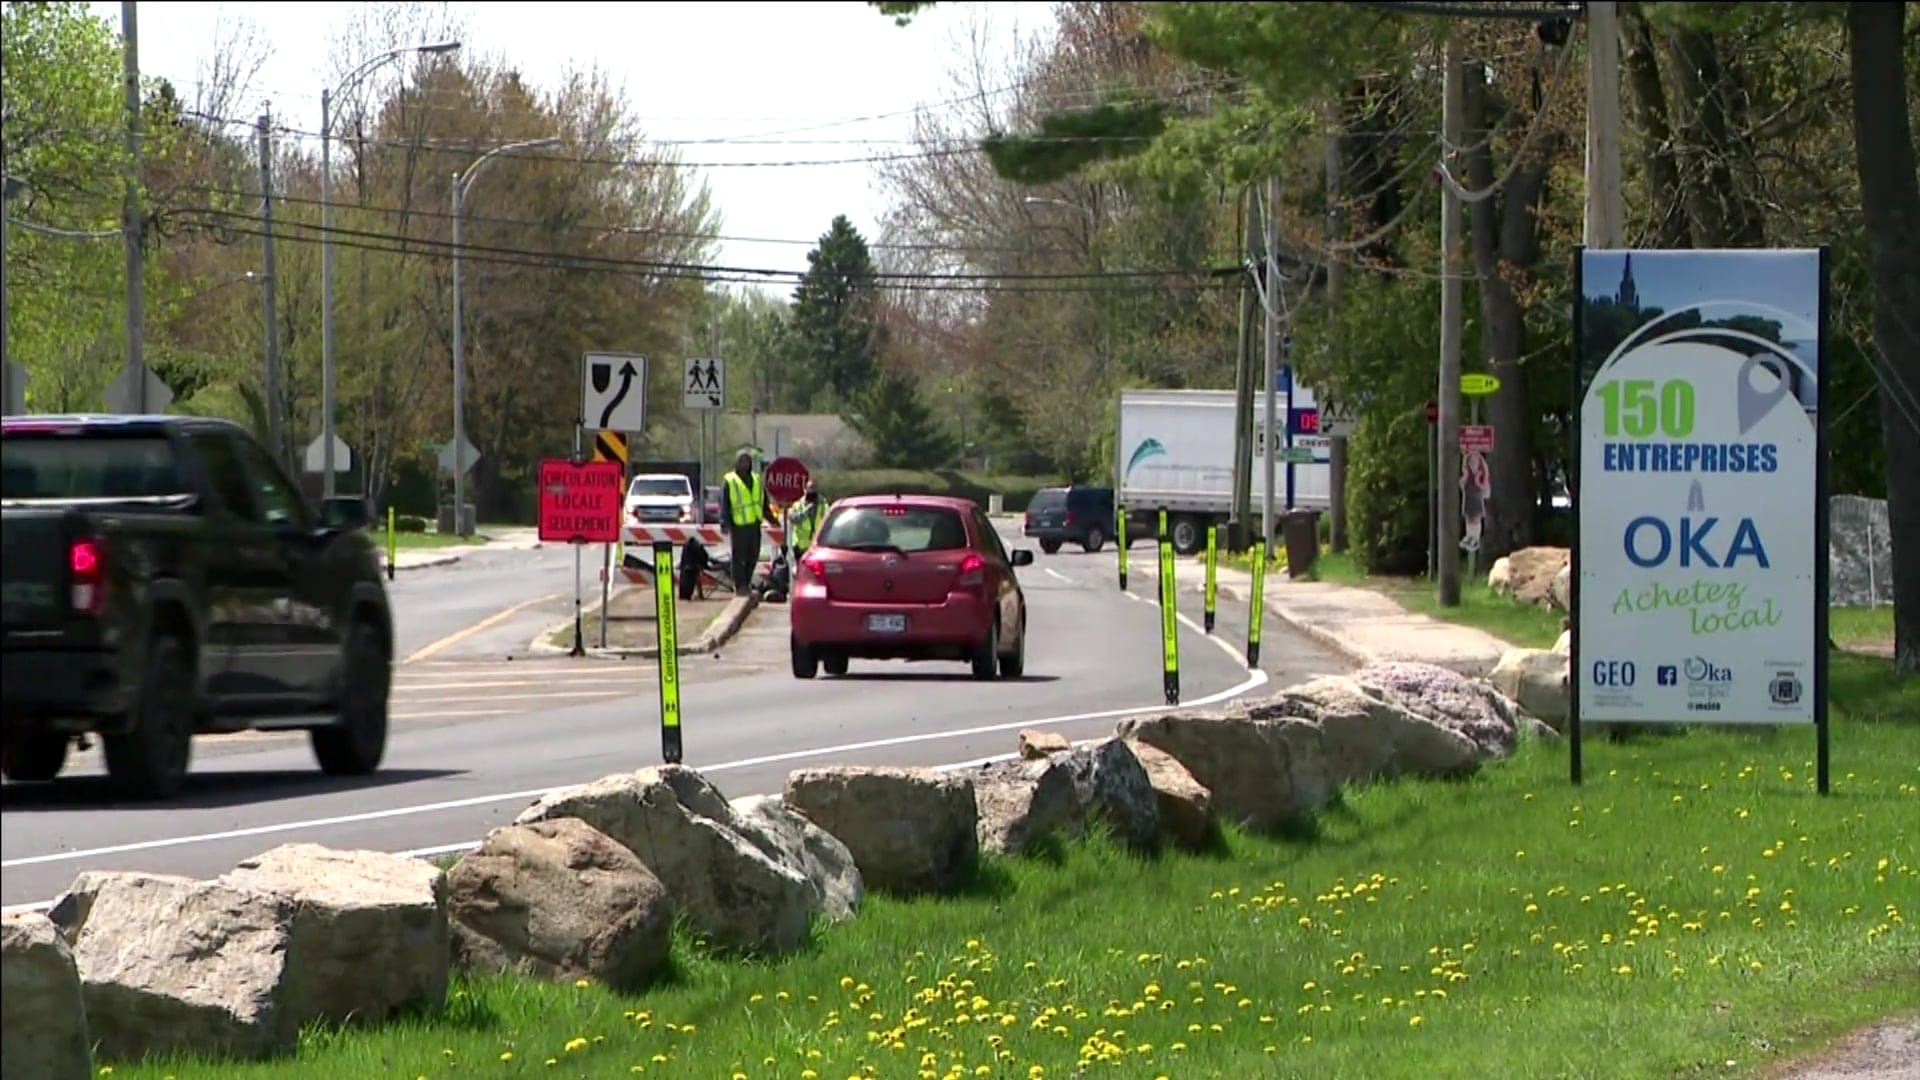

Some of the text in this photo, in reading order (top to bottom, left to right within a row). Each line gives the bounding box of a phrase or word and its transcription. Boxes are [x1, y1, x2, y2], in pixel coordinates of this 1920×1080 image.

[1596, 379, 1695, 438] 150
[1604, 443, 1777, 472] ENTREPRISES
[768, 471, 808, 489] ARRÊT
[555, 493, 603, 509] LOCALE
[549, 514, 611, 532] SEULEMENT
[1623, 516, 1770, 569] OKA
[1612, 578, 1748, 615] Achetez
[1688, 597, 1782, 635] local
[663, 639, 674, 684] Corridor
[1593, 660, 1635, 687] GEO
